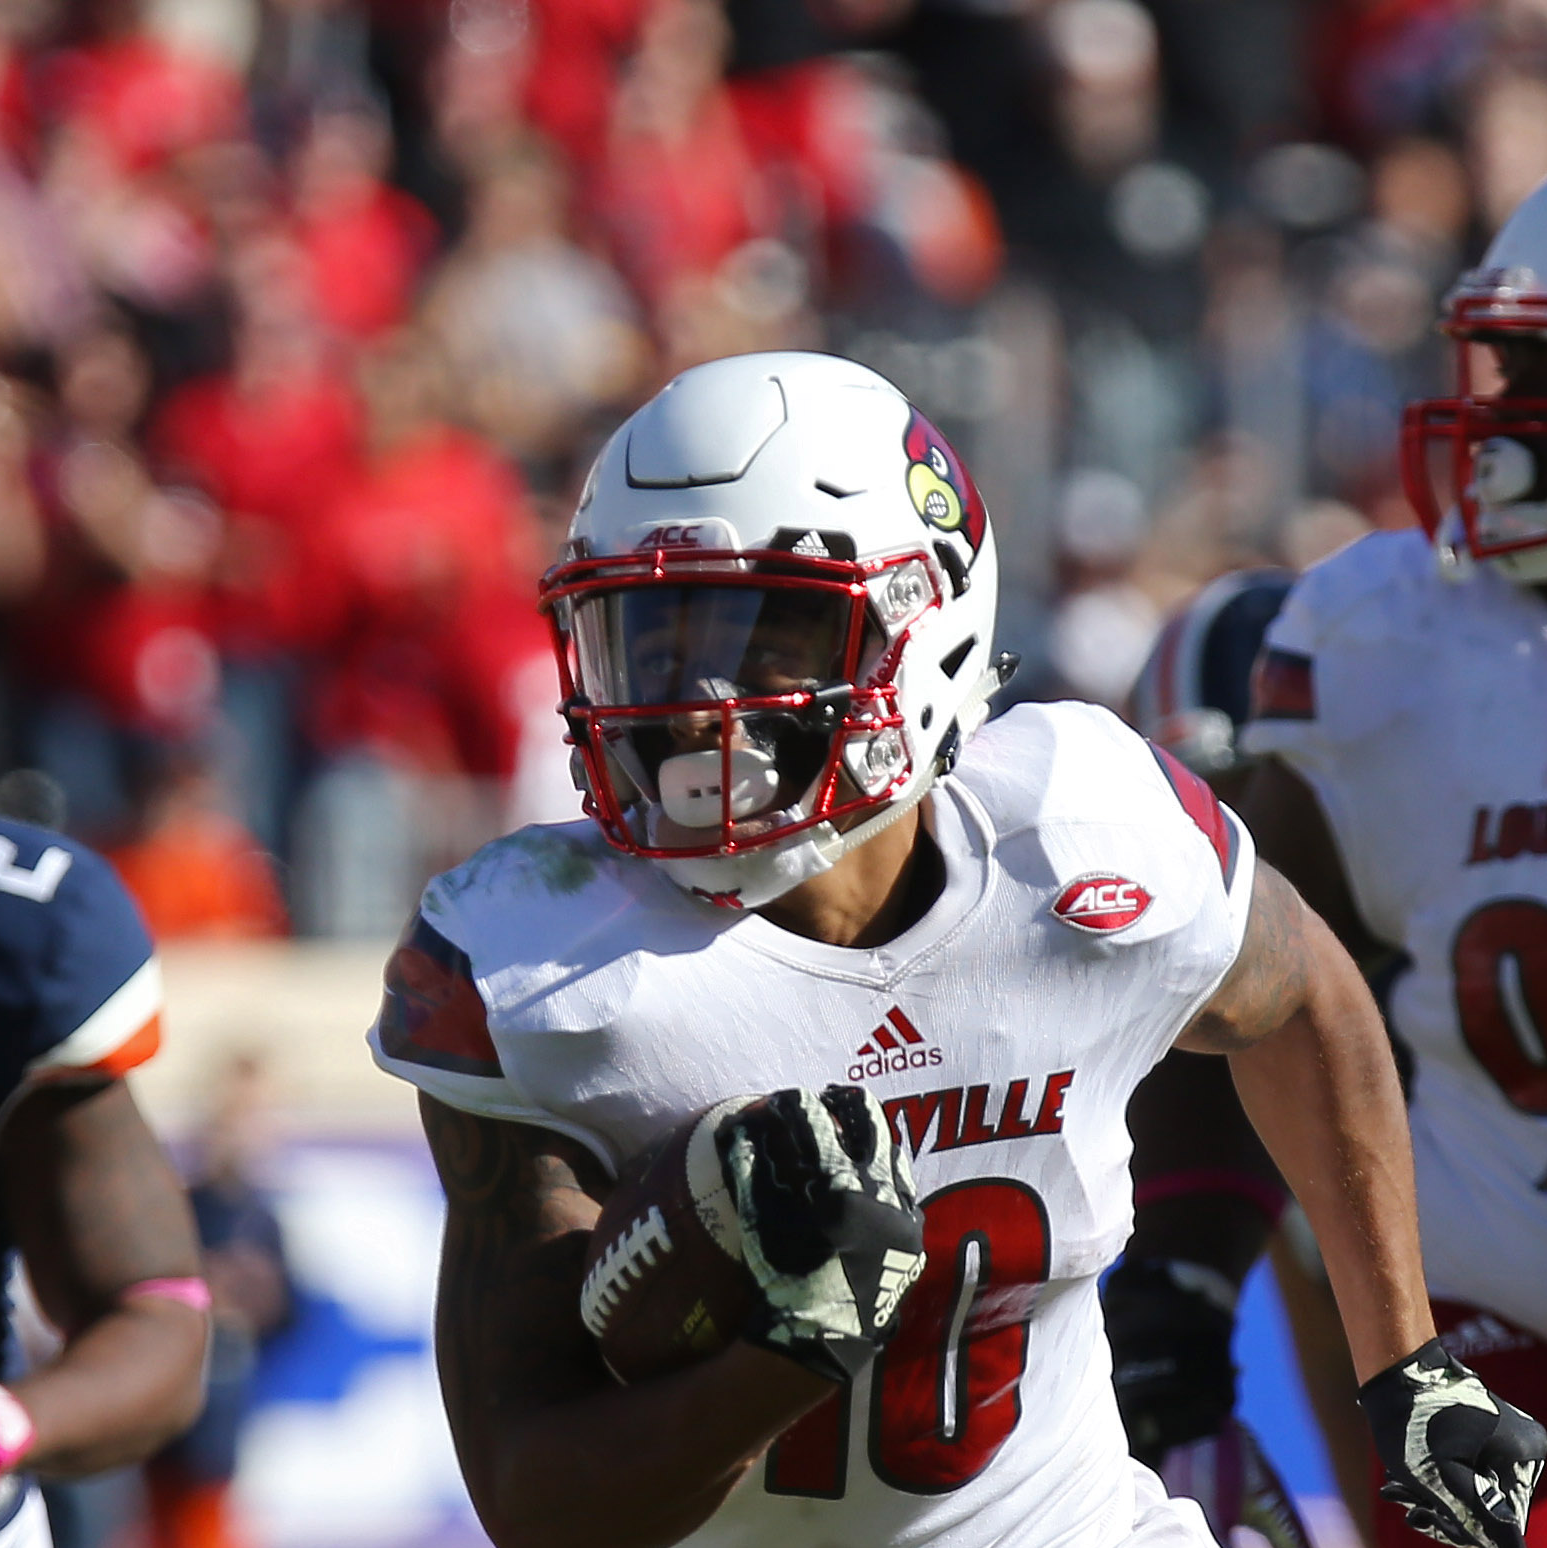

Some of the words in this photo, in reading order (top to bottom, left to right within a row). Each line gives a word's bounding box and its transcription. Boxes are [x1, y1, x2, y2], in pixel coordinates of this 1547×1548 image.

[637, 526, 704, 547] ACC
[1066, 882, 1139, 913] ACC
[847, 1045, 944, 1082] adidas
[873, 1250, 929, 1329] adidas
